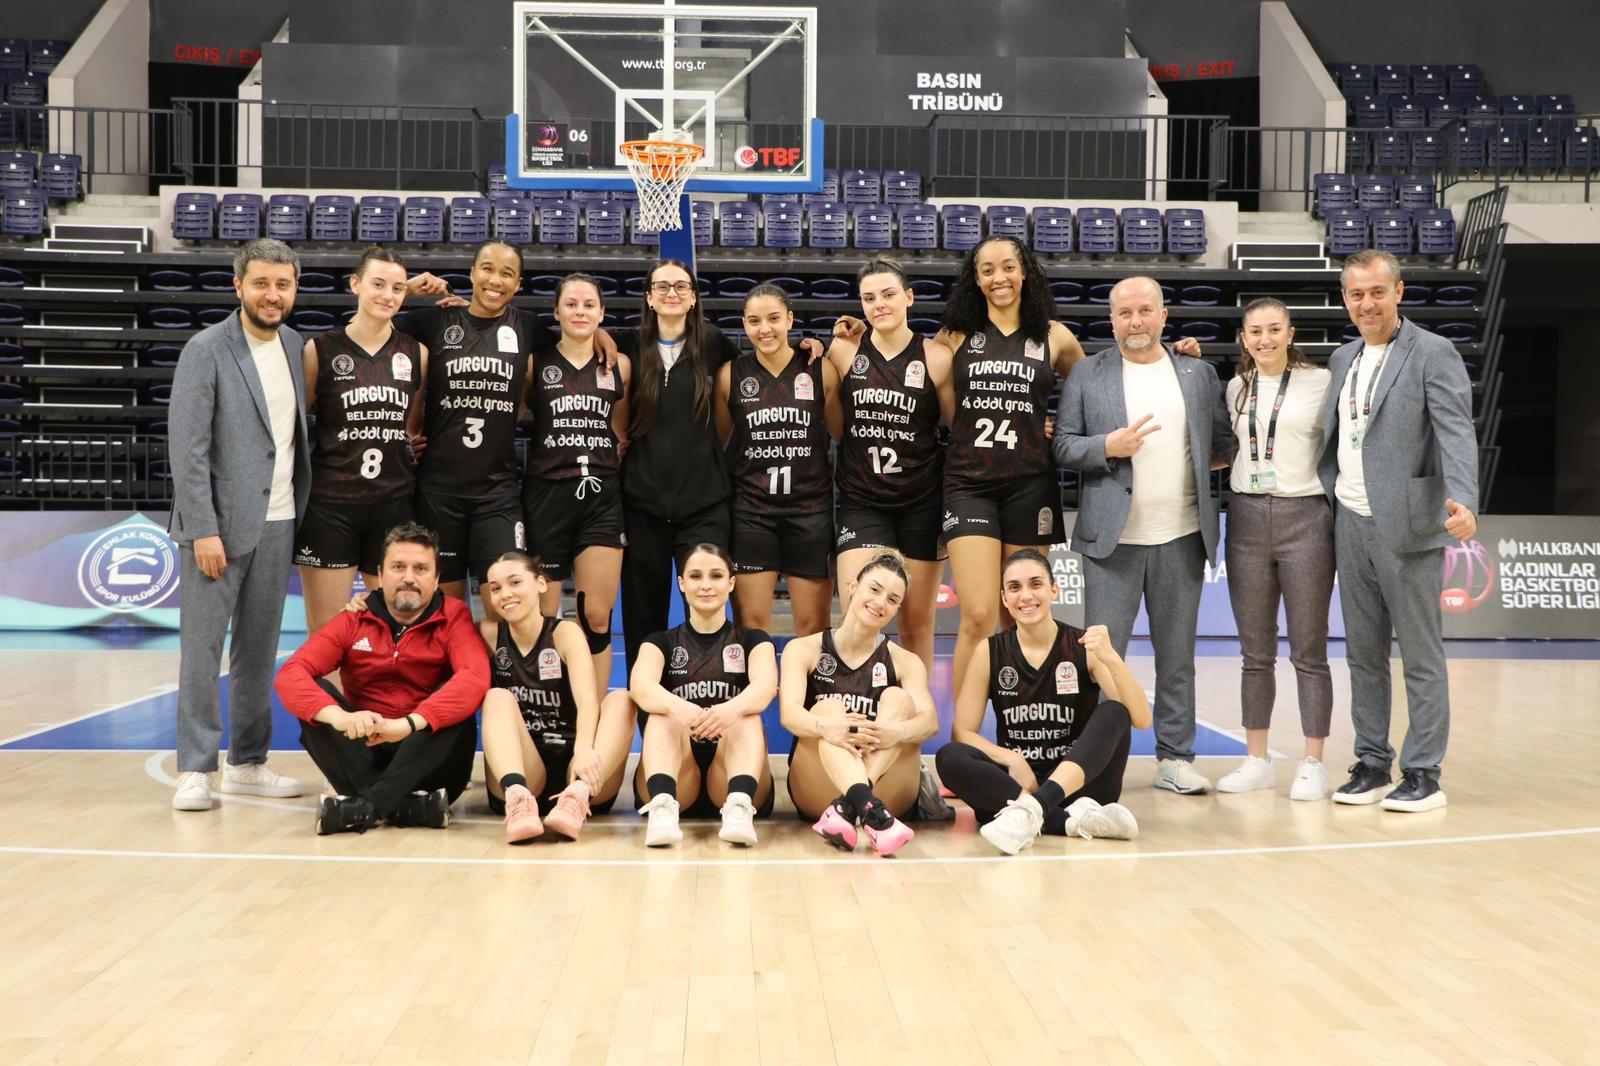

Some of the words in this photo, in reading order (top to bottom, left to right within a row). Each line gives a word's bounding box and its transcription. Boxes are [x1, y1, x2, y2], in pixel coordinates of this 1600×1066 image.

[1197, 60, 1236, 77] EXIT
[917, 72, 982, 89] BASIN
[908, 91, 1003, 111] TRİBÜNÜ
[569, 129, 588, 142] 06
[759, 147, 801, 167] TBF
[445, 356, 513, 380] TURGUTLU
[968, 360, 1035, 382] TURGUTLU
[449, 379, 509, 392] BELEDİYESİ
[970, 380, 1030, 393] BELEDİYESİ
[341, 386, 408, 409] TURGUTLU
[484, 398, 514, 413] gross
[550, 394, 611, 418] TURGUTLU
[852, 388, 916, 413] TURGUTLU
[347, 408, 404, 421] BELEDİYESİ
[746, 406, 811, 429] TURGUTLU
[855, 410, 910, 424] BELEDİYESİ
[462, 417, 485, 449] 3
[751, 428, 807, 440] BELEDİYESİ
[887, 428, 916, 442] gross
[974, 418, 1018, 450] 24
[360, 448, 383, 479] 8
[577, 455, 589, 476] 1
[867, 446, 902, 474] 12
[767, 466, 791, 495] 11
[102, 531, 137, 550] EMLAK
[139, 531, 168, 550] KONUT
[1500, 561, 1596, 578] KADINLAR
[95, 585, 119, 602] SPOR
[1501, 577, 1600, 593] BASKETBO
[1502, 591, 1564, 609] SÜPER
[1002, 703, 1075, 726] TURGUTLU
[1007, 725, 1071, 740] BELEDİYESİ
